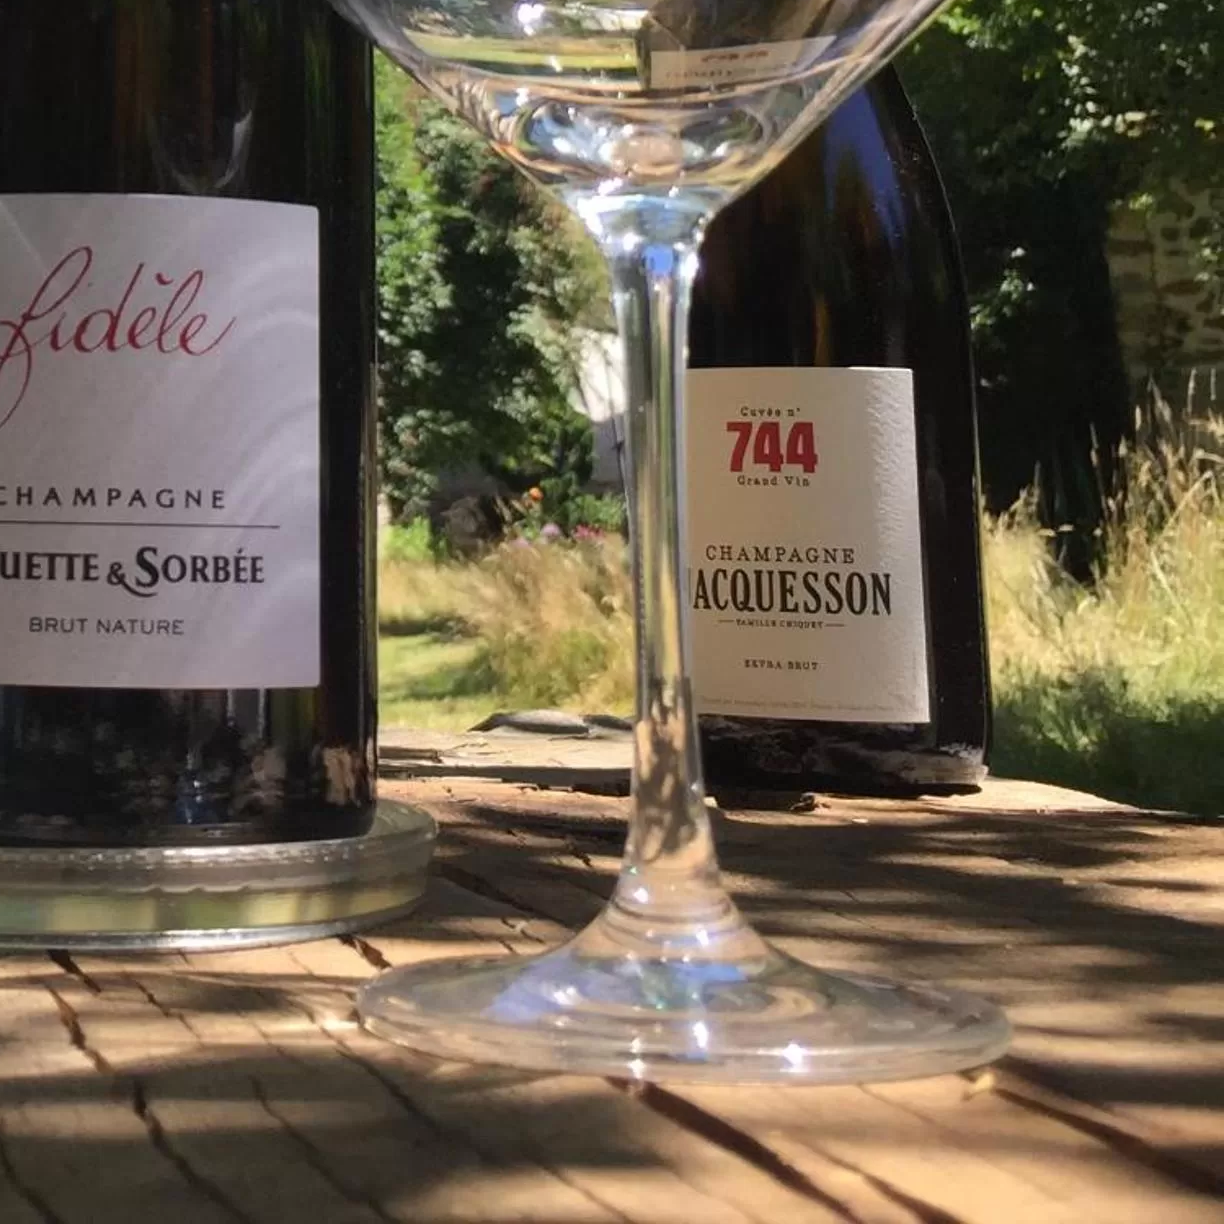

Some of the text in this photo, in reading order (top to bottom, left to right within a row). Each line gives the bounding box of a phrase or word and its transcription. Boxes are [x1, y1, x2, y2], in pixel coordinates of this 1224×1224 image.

[740, 405, 782, 417] Cuvée
[726, 421, 818, 474] 744
[736, 475, 811, 488] Grand Vin
[705, 544, 856, 564] CHAMPAGNE
[135, 545, 266, 589] SORBÉE
[690, 568, 892, 616] ACQUESSON
[28, 617, 185, 636] BRUT NATURE
[787, 660, 820, 671] BRUT
